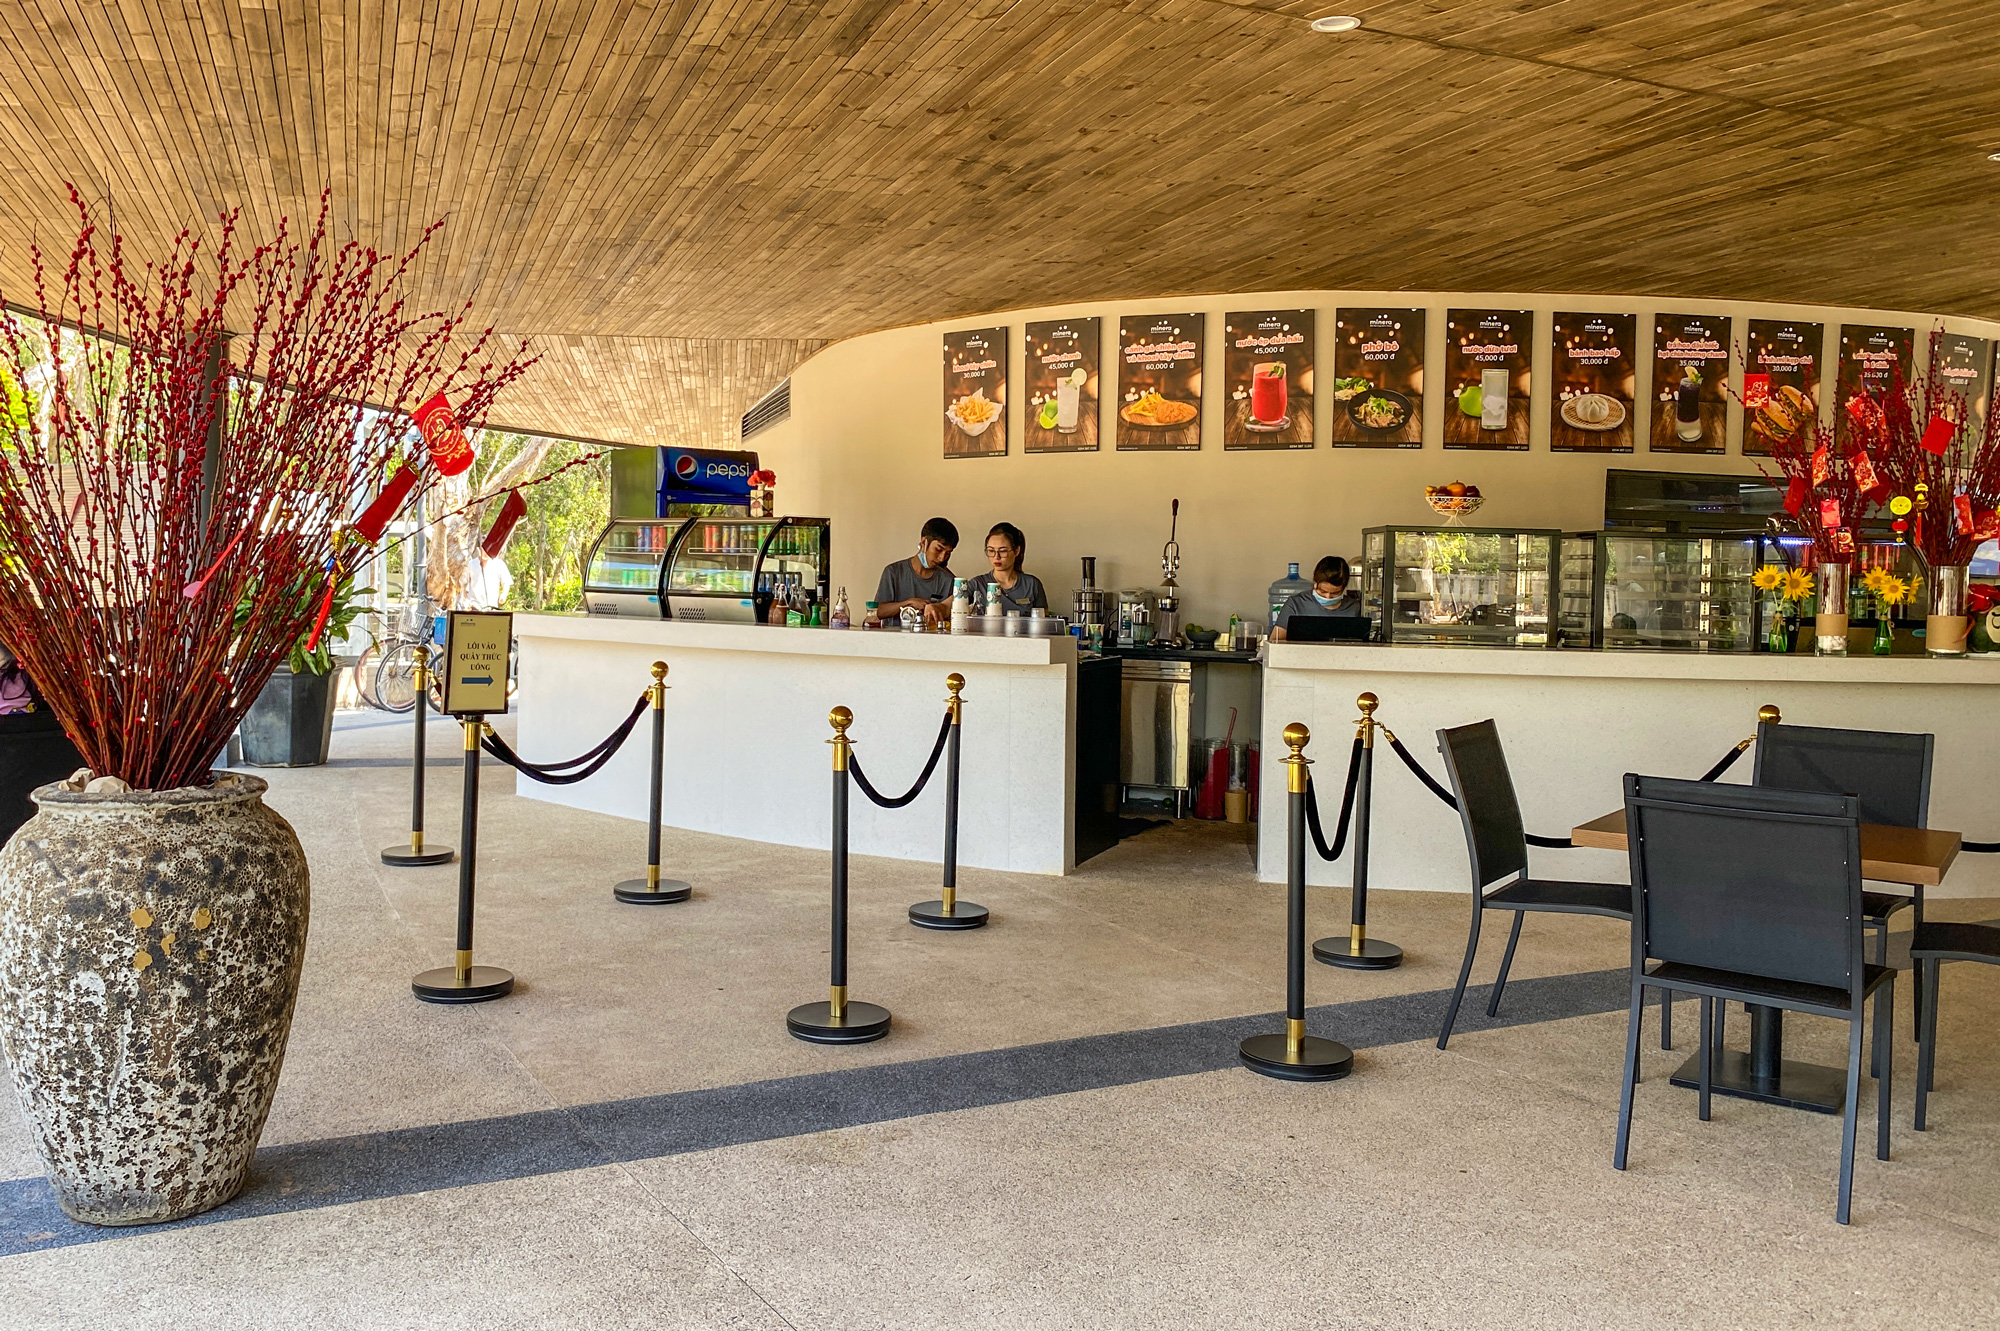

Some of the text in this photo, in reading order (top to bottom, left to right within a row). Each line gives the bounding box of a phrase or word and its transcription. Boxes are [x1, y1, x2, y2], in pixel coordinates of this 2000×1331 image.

[1236, 333, 1304, 347] nước ép dưa hấu
[1144, 344, 1155, 354] gà
[1155, 342, 1176, 351] chiên
[1361, 340, 1399, 353] phở bò
[1462, 344, 1517, 354] nước dừa tươi
[1060, 351, 1082, 361] chanh
[1126, 350, 1195, 363] và khoai tây chiên
[1569, 347, 1621, 358] bánh bao hấp
[1707, 350, 1727, 358] chanh
[1049, 362, 1068, 370] 45,000
[706, 462, 750, 479] pepsi
[482, 642, 496, 650] VÀO
[470, 663, 490, 671] UỐNG
